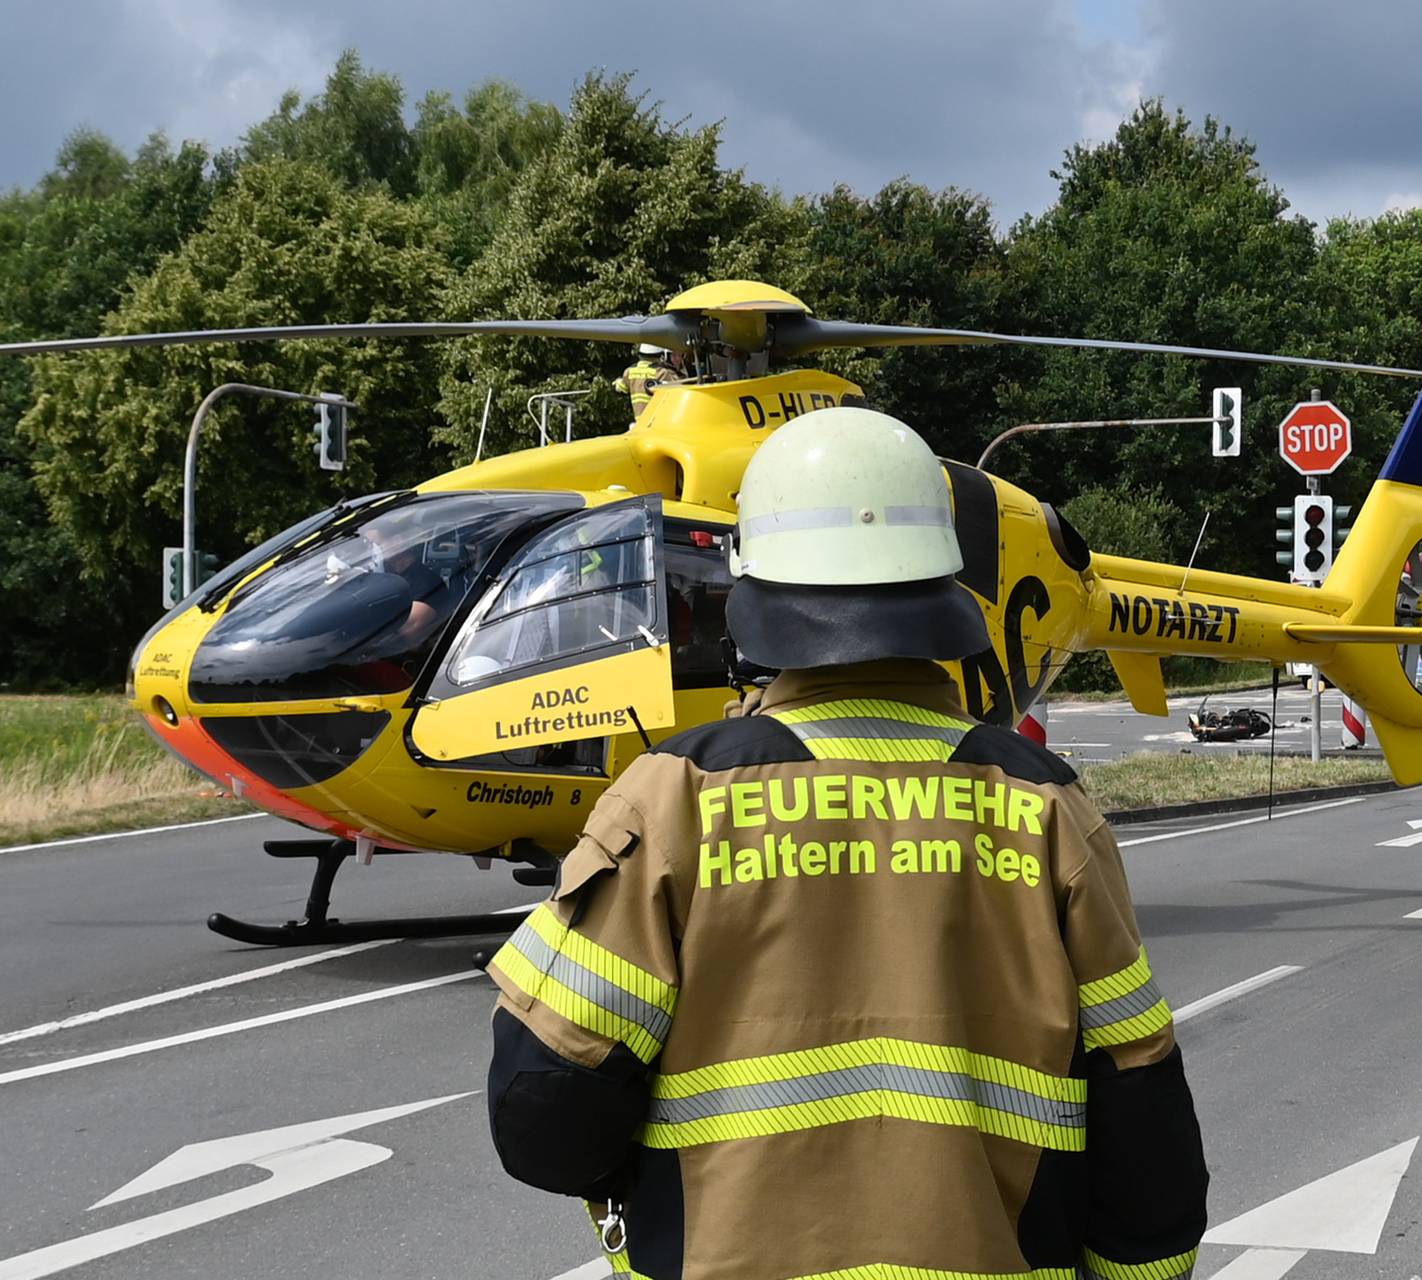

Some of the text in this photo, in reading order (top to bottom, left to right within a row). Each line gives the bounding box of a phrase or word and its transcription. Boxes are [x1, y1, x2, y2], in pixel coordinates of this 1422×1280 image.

[1286, 423, 1343, 453] STOP
[1108, 592, 1241, 644] NOTARZT
[531, 686, 590, 711] ADAC
[496, 707, 628, 739] Luftrettung
[466, 780, 581, 809] Christoph 8
[698, 774, 1045, 836] FEUERWEHR
[699, 832, 1042, 889] Haltern am See
